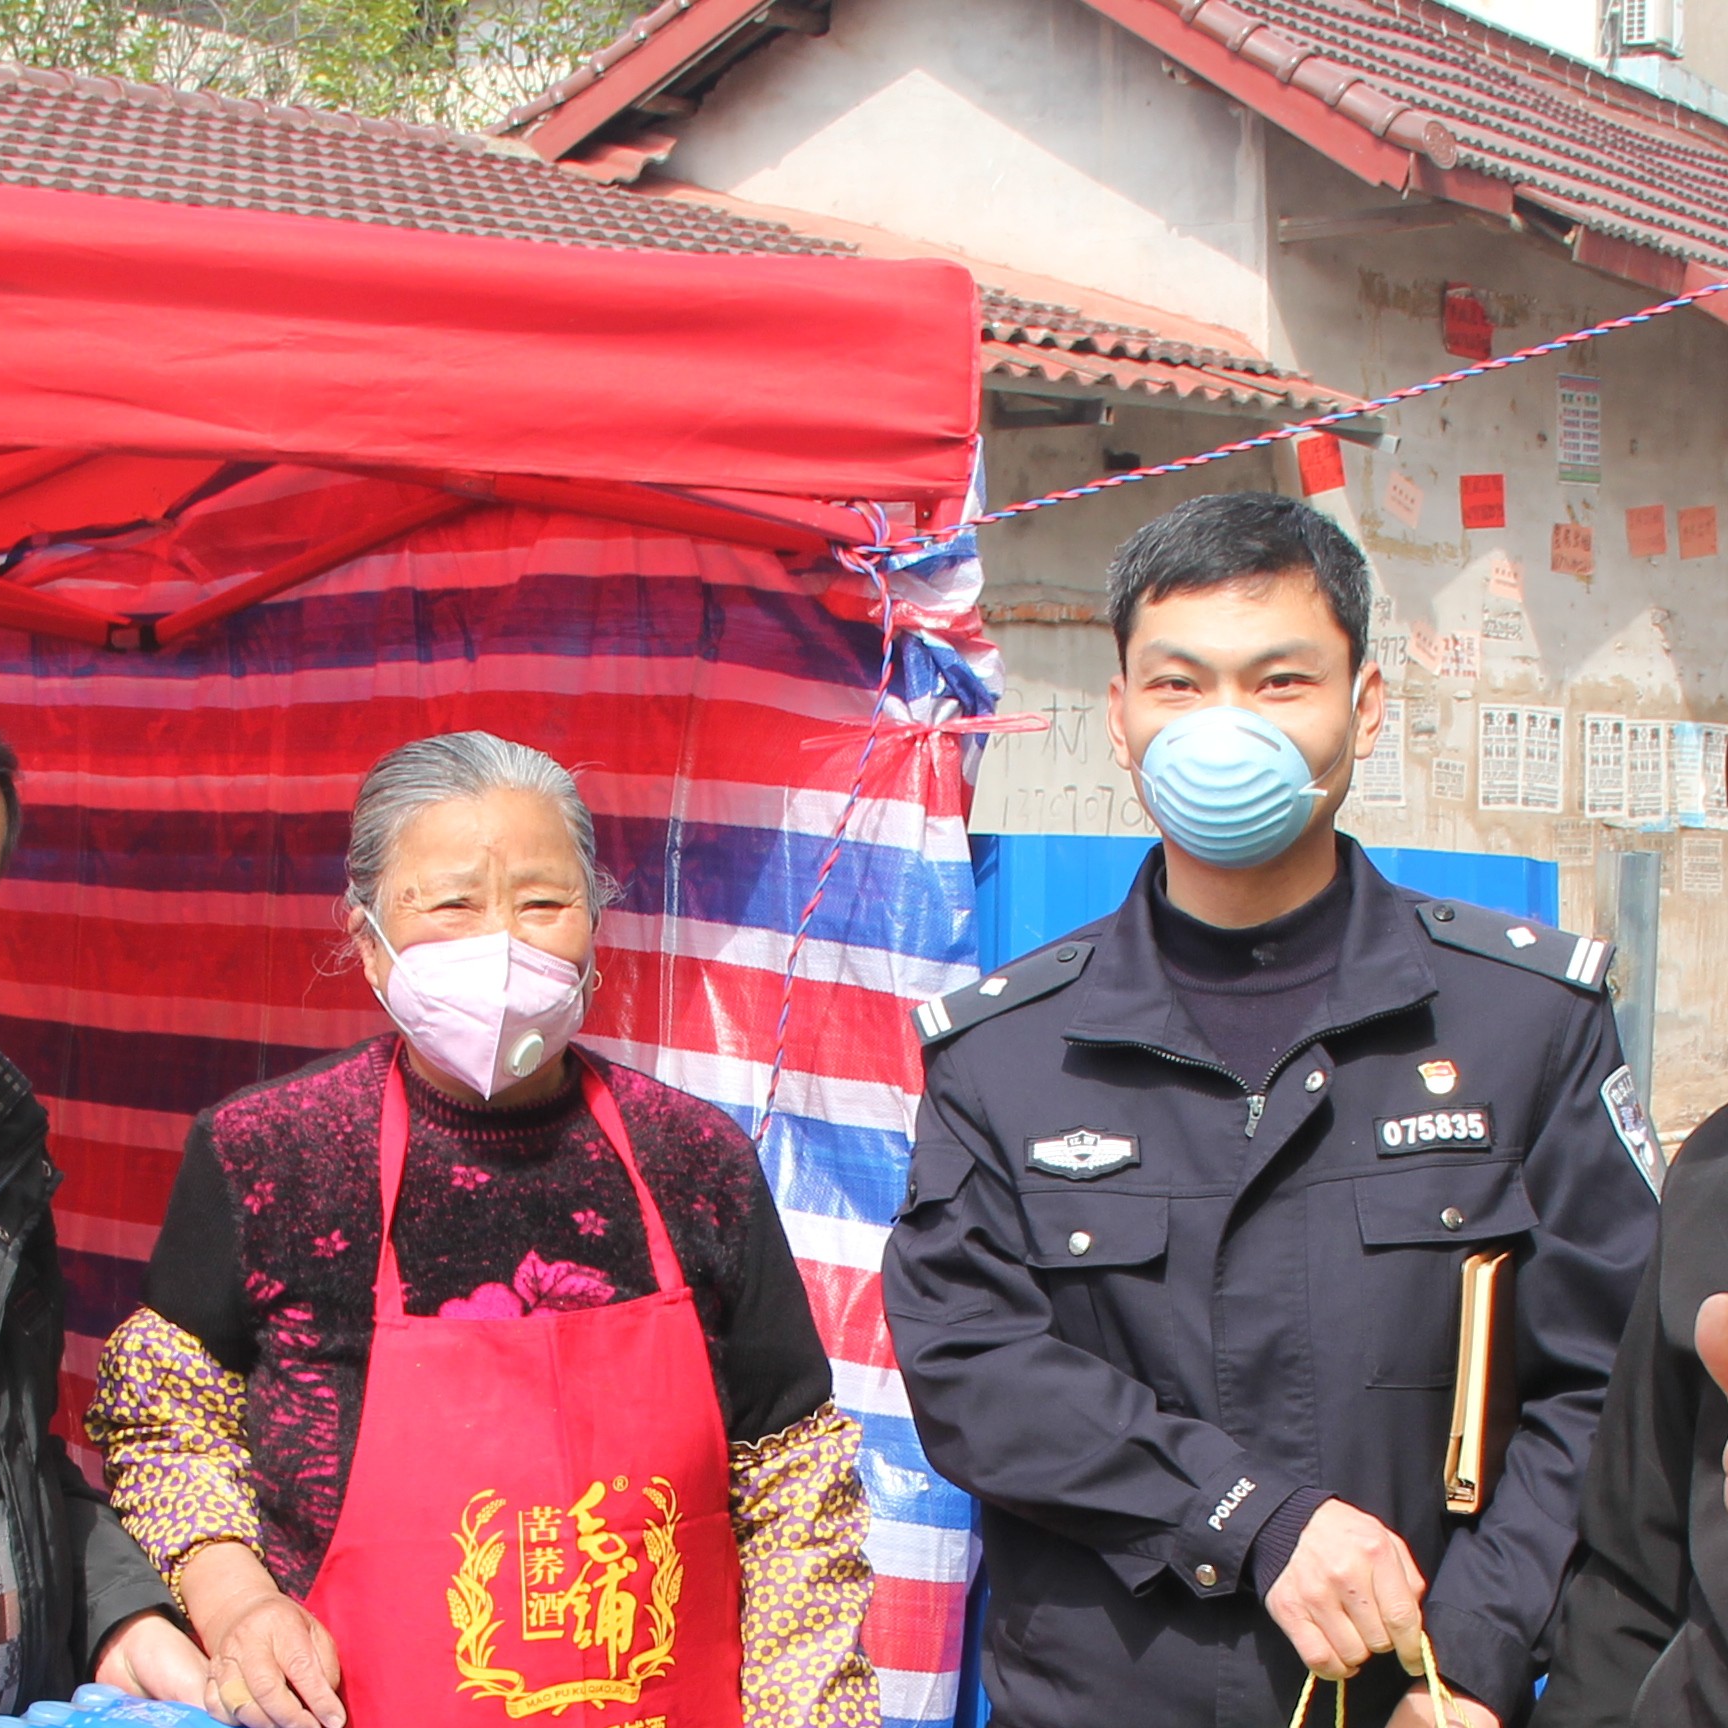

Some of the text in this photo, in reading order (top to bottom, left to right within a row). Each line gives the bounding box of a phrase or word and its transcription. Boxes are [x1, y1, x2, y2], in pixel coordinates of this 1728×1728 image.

[1383, 1112, 1486, 1146] 075835
[1208, 1476, 1256, 1532] POLICE
[524, 1506, 566, 1627] 苦荞酒
[526, 1693, 552, 1710] MAO
[554, 1688, 570, 1699] PU
